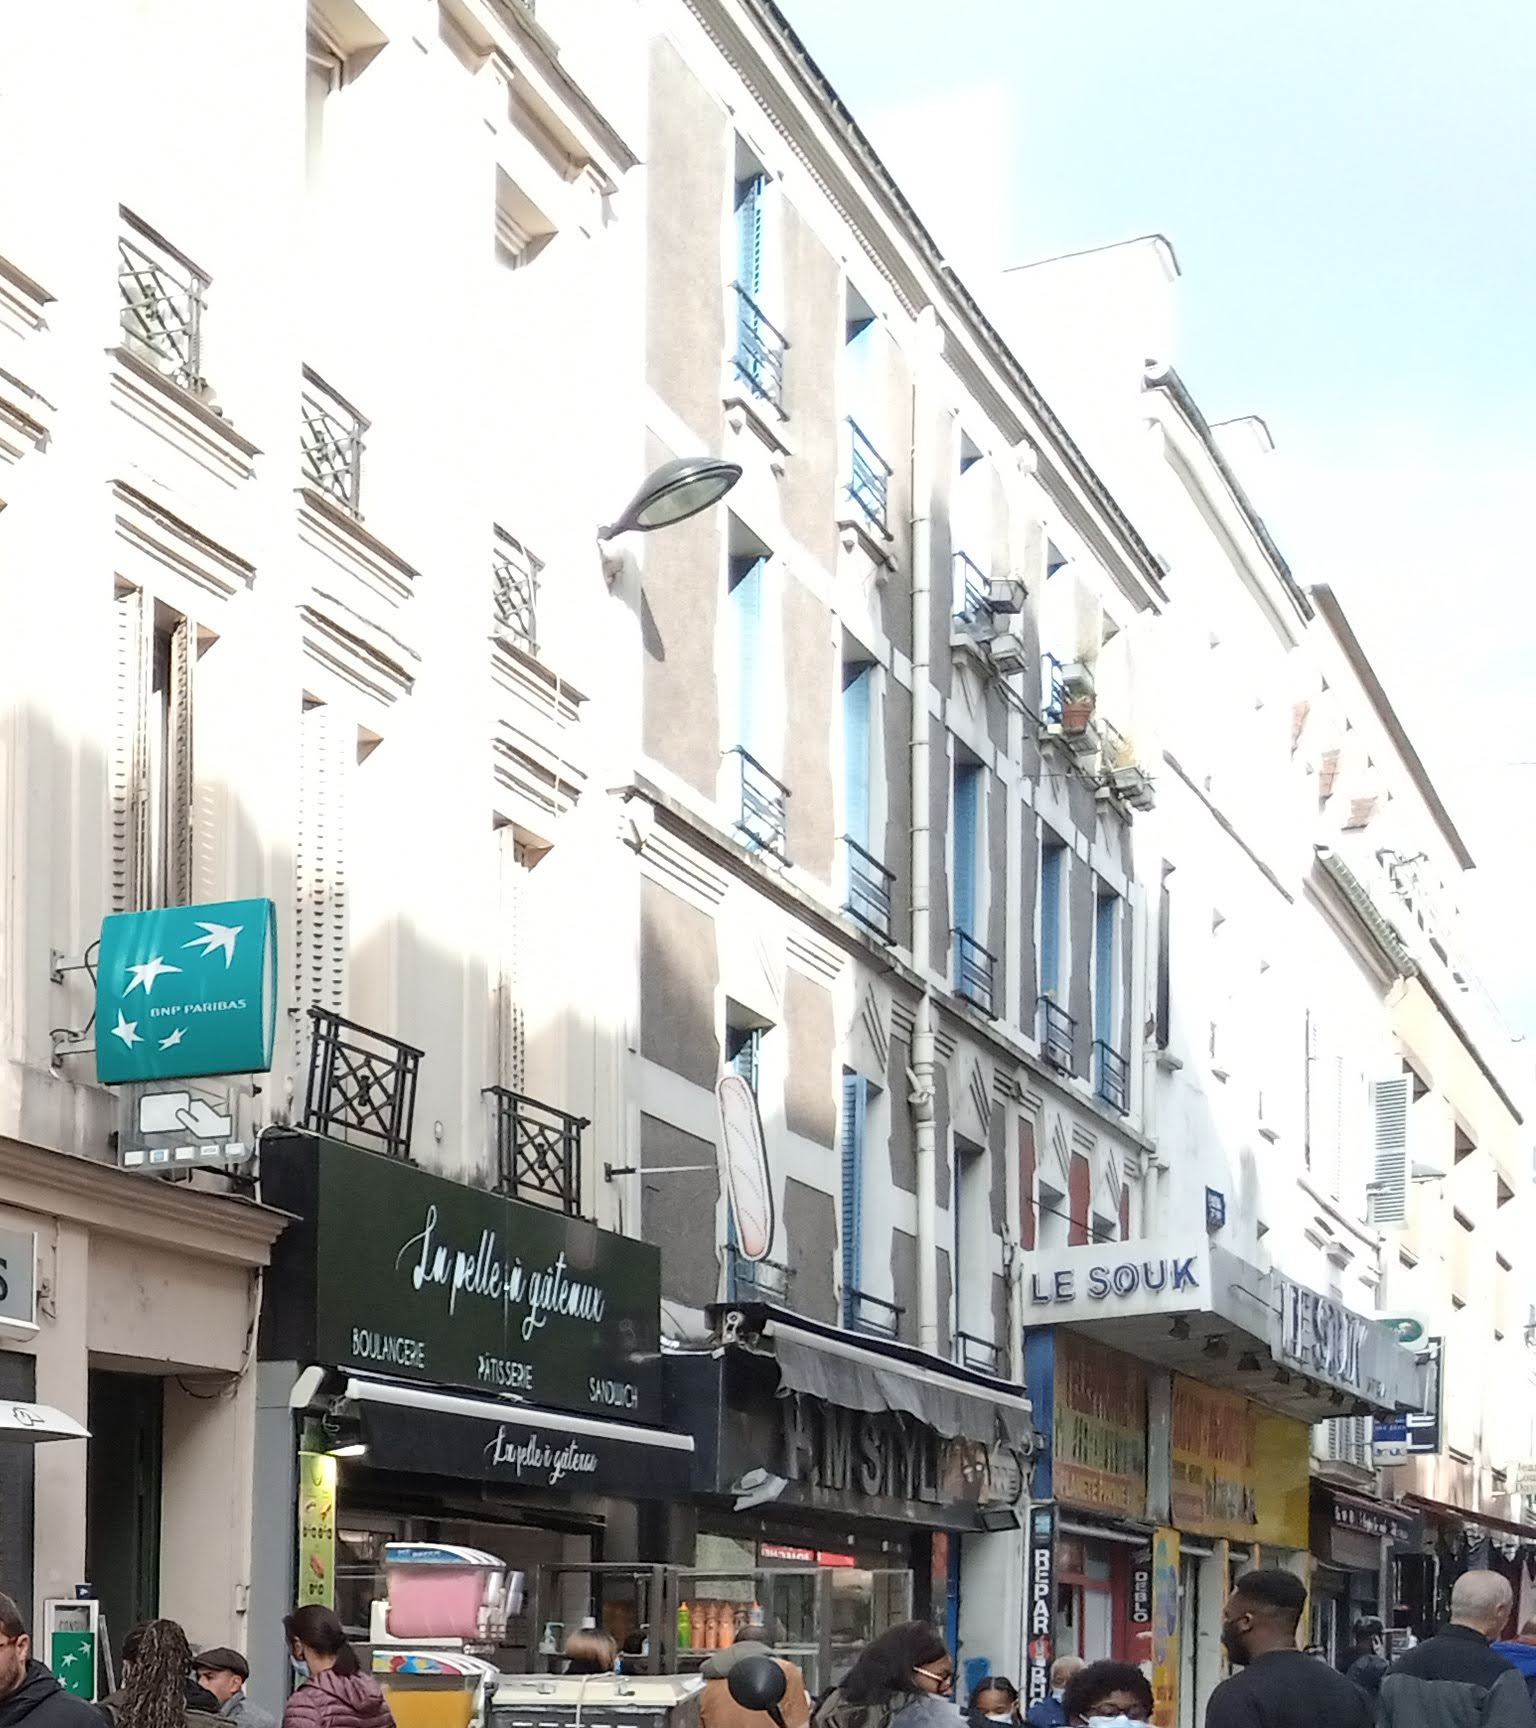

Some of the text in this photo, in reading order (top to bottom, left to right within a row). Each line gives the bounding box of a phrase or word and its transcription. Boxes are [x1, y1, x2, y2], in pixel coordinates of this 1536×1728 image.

[149, 998, 247, 1018] BNP PARIBAS
[395, 1204, 453, 1290] La
[449, 1229, 506, 1317] pelle
[521, 1250, 606, 1342] gâteaux
[1031, 1254, 1201, 1304] LE SOUK
[352, 1327, 639, 1409] BOULANGERIE PÂTISSERIE SANDWICH
